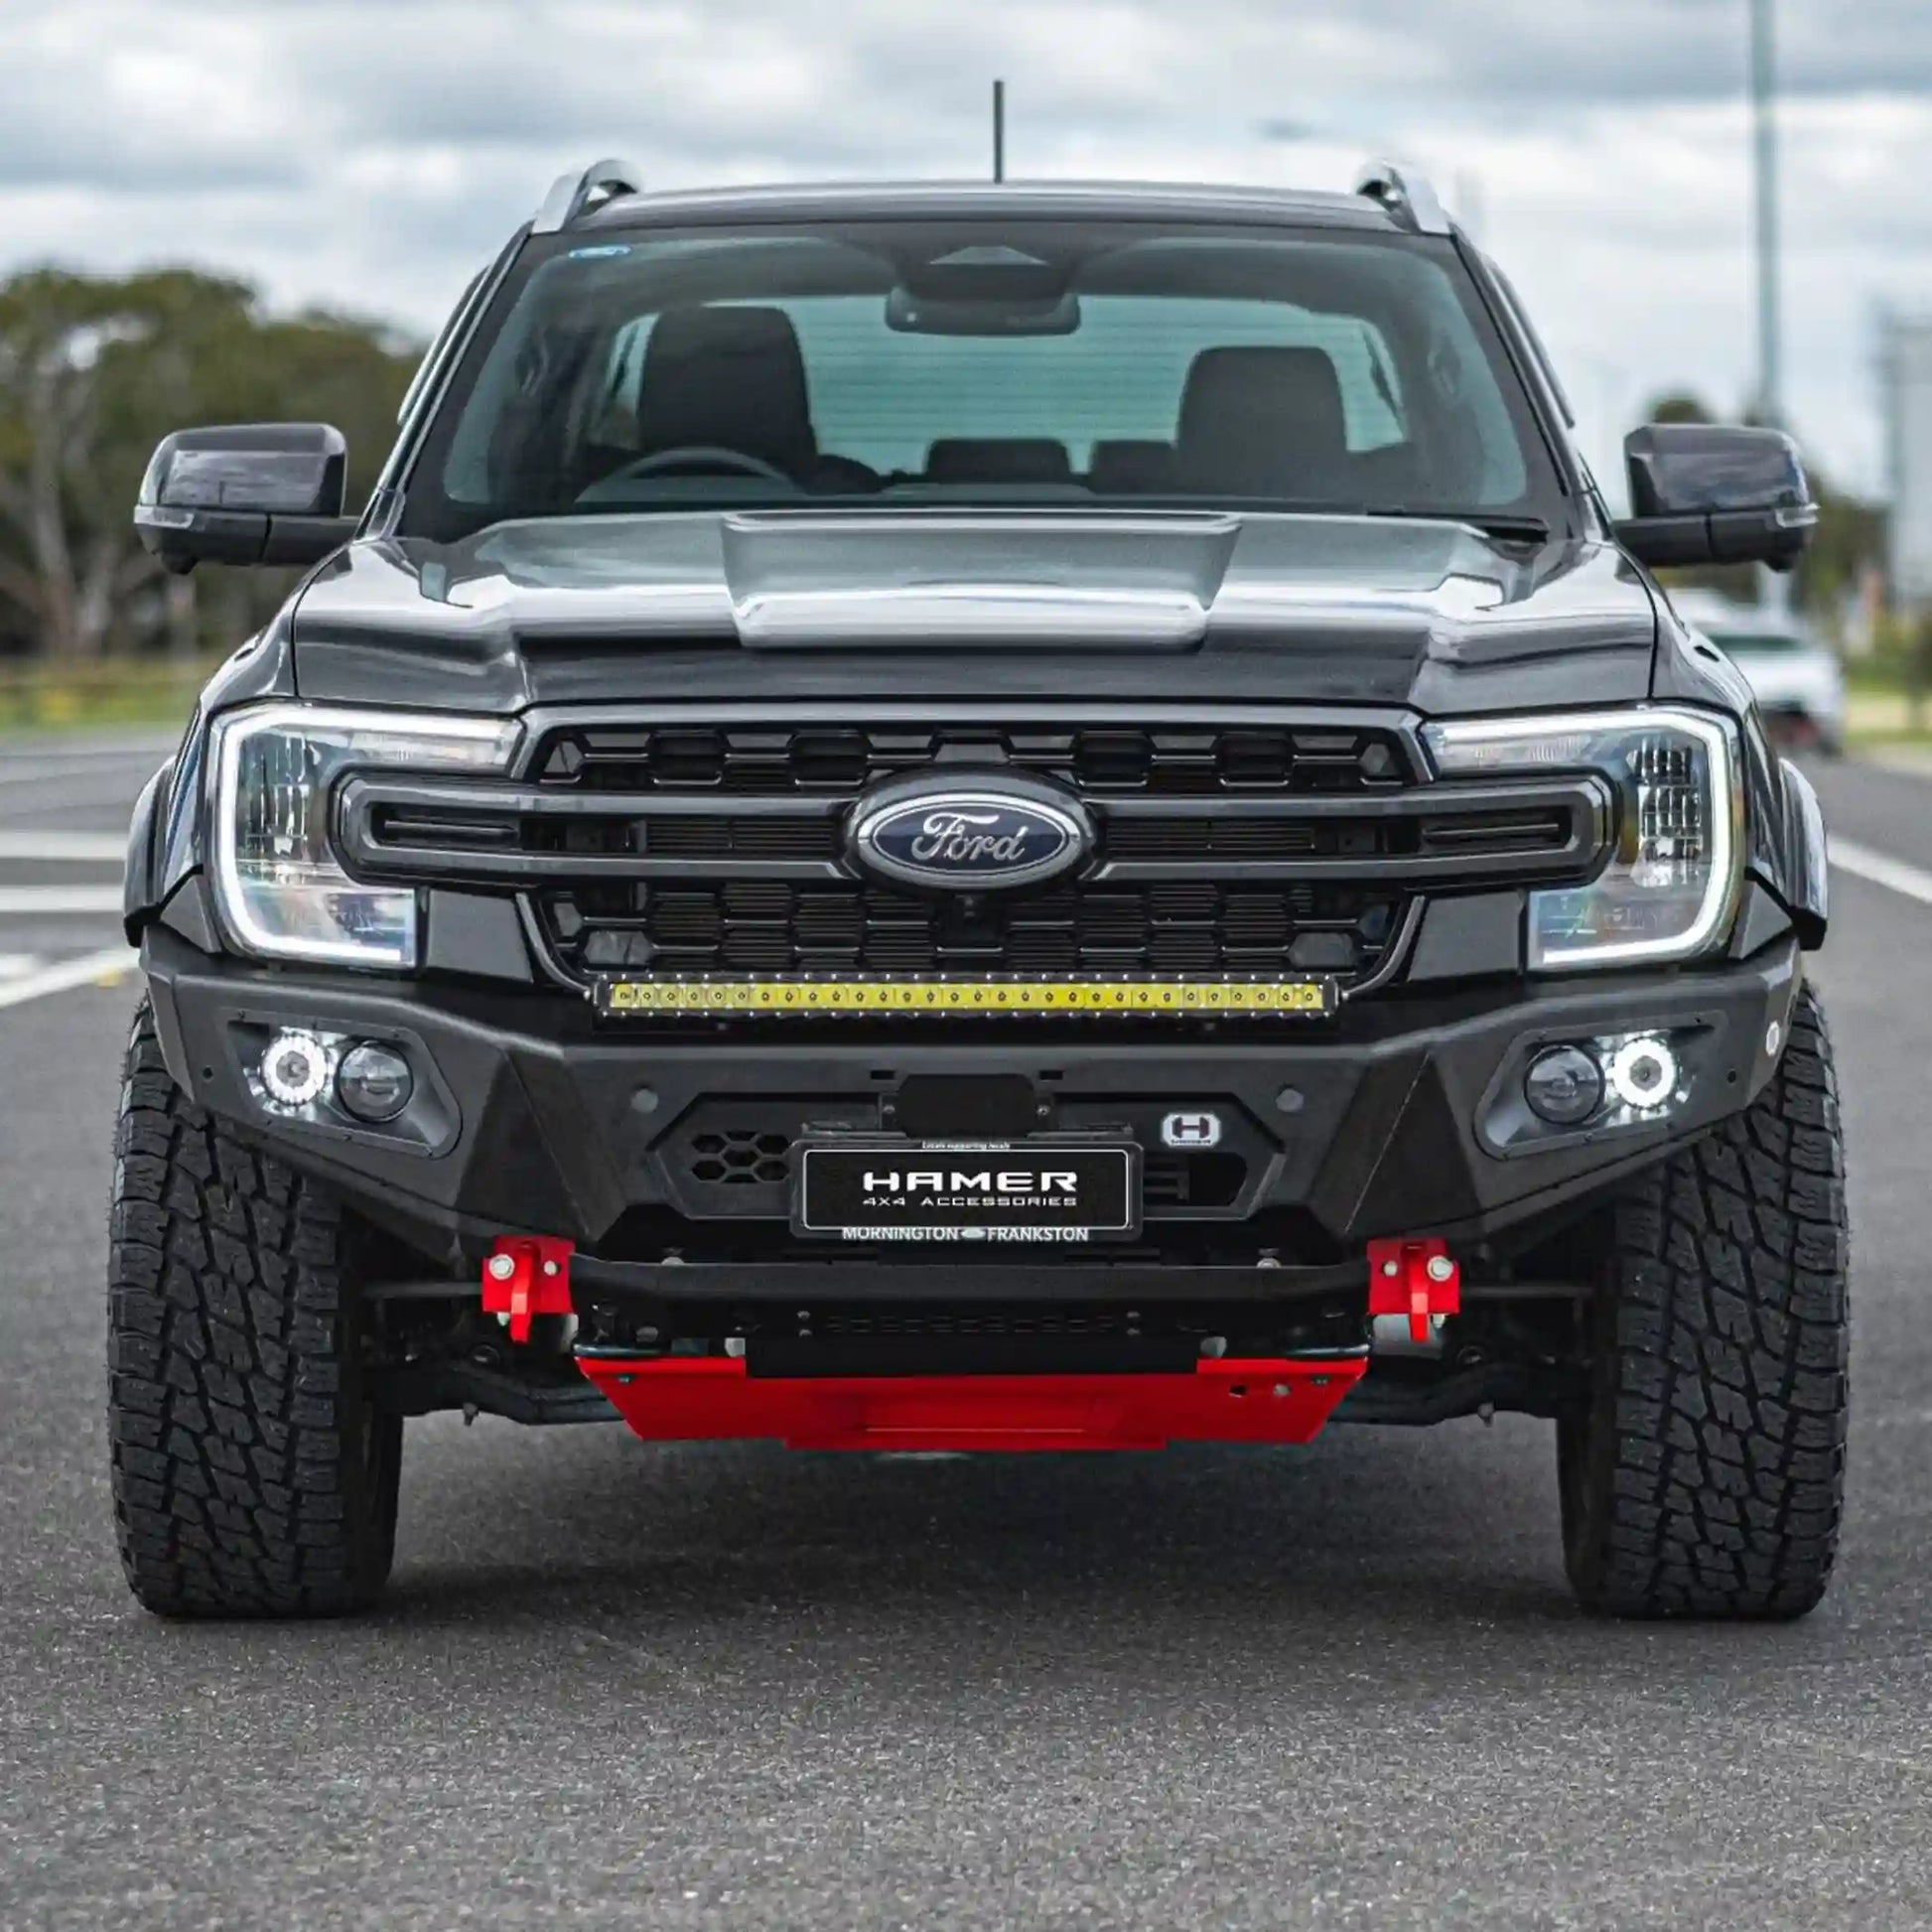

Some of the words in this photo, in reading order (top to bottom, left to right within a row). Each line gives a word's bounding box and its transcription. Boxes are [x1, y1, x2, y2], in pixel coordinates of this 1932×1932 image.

[911, 812, 1029, 861] Ford
[863, 1172, 1078, 1191] HAMER
[920, 1196, 1077, 1206] ACCESSORIES
[843, 1226, 958, 1241] MORNINGTON
[988, 1226, 1089, 1241] FRANKSTON
